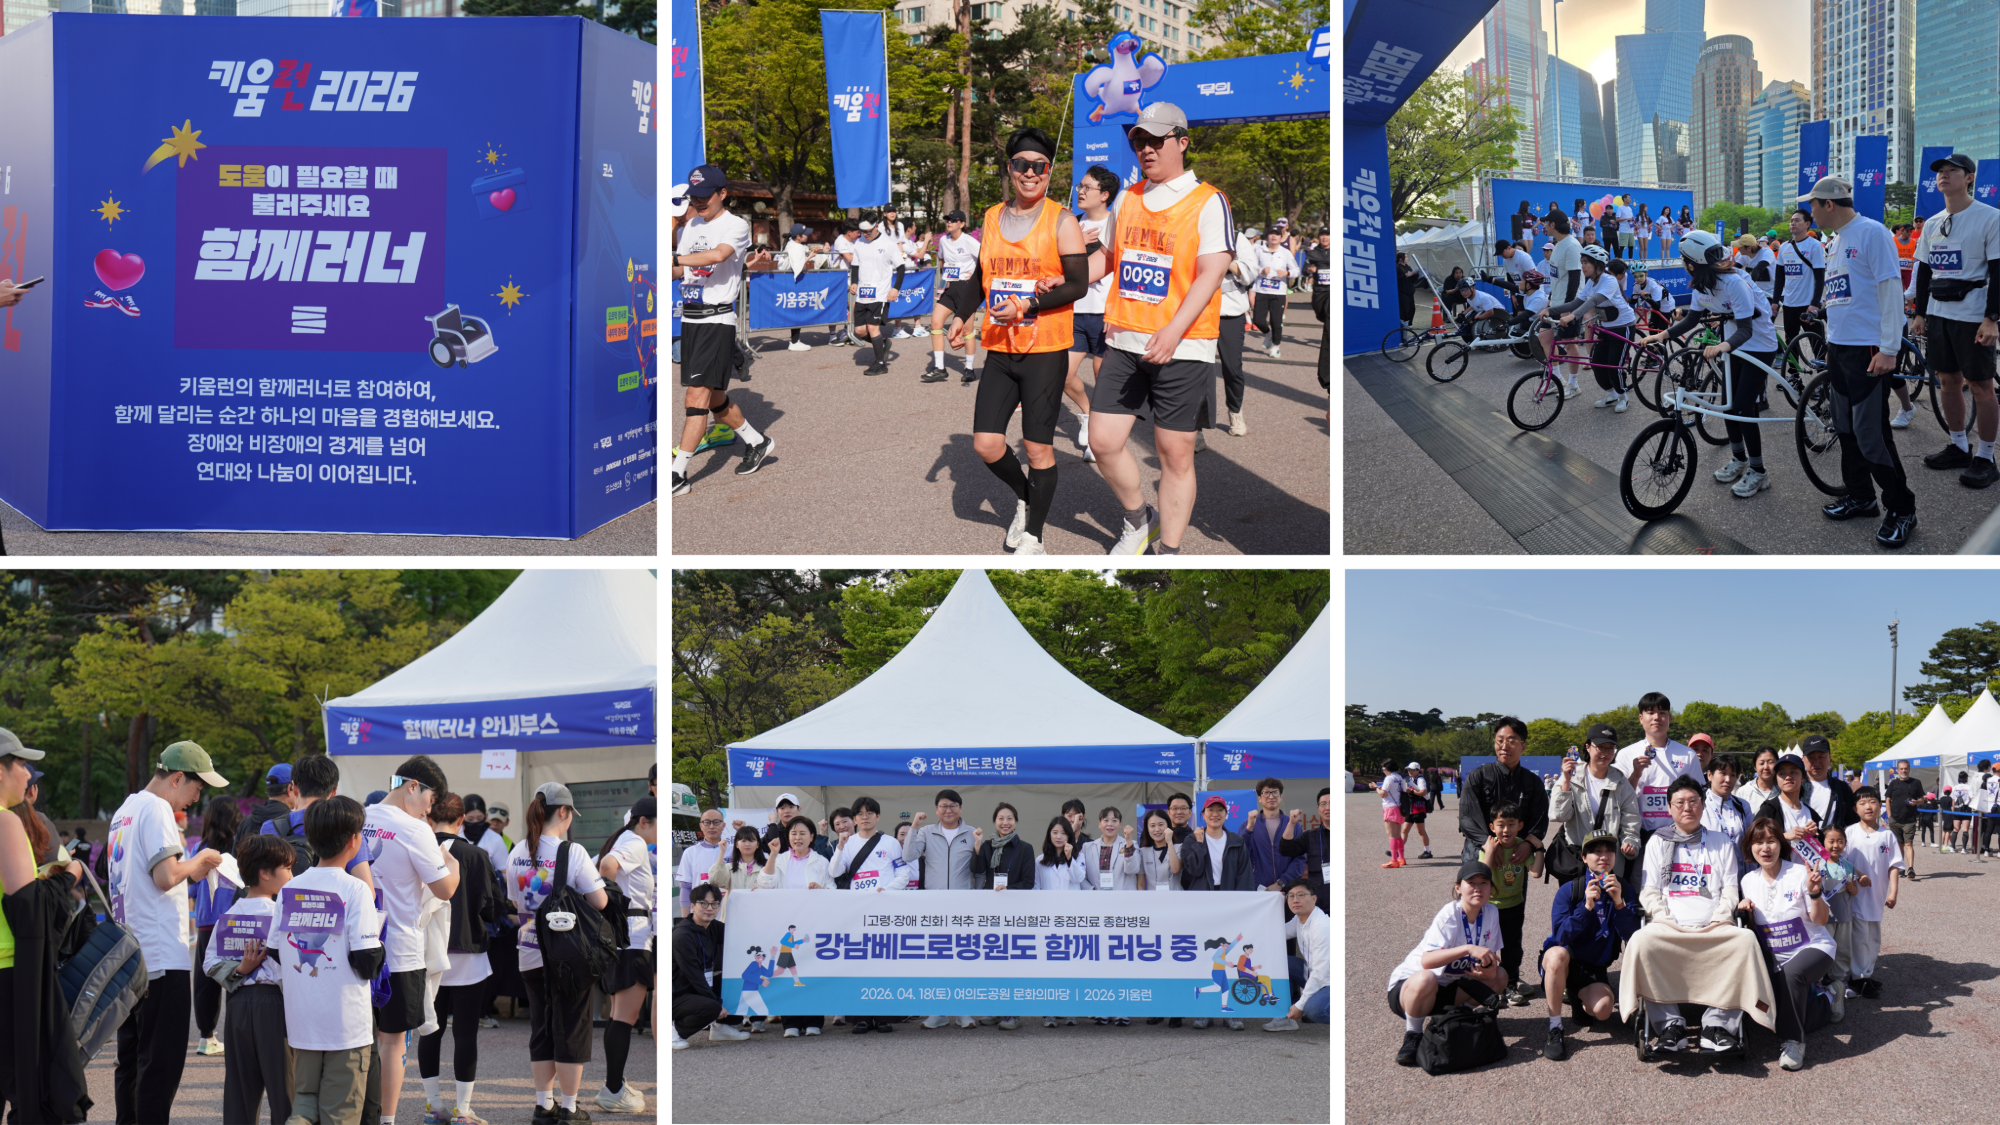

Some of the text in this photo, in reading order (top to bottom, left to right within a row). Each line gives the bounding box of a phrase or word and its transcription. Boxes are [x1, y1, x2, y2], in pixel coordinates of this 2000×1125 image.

[208, 58, 419, 117] 키움런 2026
[833, 92, 881, 122] 키움런
[1086, 142, 1109, 151] bigwalk
[218, 164, 398, 189] 도움이 필요할 때
[602, 163, 613, 178] 코스
[1857, 172, 1883, 187] 키움런
[1922, 180, 1939, 193] 키움
[252, 193, 370, 217] 불러주세요
[194, 227, 427, 283] 함께러너
[1928, 253, 1959, 265] 0024
[1123, 265, 1165, 287] 0098
[1343, 236, 1380, 310] 2026
[775, 290, 821, 310] 키움증권
[179, 377, 437, 402] 키움런의 함께러너로 참여하여,
[114, 405, 500, 430] 함께 달리는 순간 하나의 마음을 경험해보세요.
[187, 433, 426, 457] 장애와 비장애의 경계를 넘어
[196, 462, 417, 485] 연대와 나눔이 이어집니다.
[340, 721, 373, 745] 키움런
[402, 712, 560, 740] 함께러너 안내부스
[745, 760, 775, 778] 키움런
[930, 756, 1017, 771] 강남베드로병원
[1223, 753, 1254, 771] 키움런
[1646, 796, 1668, 807] 351
[854, 878, 878, 890] 3699
[1672, 874, 1707, 888] 4686
[288, 911, 338, 928] 함께러너
[951, 915, 975, 928] 척추
[977, 915, 1001, 928] 관절
[1004, 915, 1051, 928] 뇌심혈관
[1053, 915, 1100, 928] 중점진료
[1103, 916, 1150, 928] 종합병원
[815, 933, 1198, 962] 강남베드로병원도 함께 러닝 중
[860, 987, 1152, 1002] 2026. 04. 18(토) 여의도공원 문화의마당 2026 키움런
